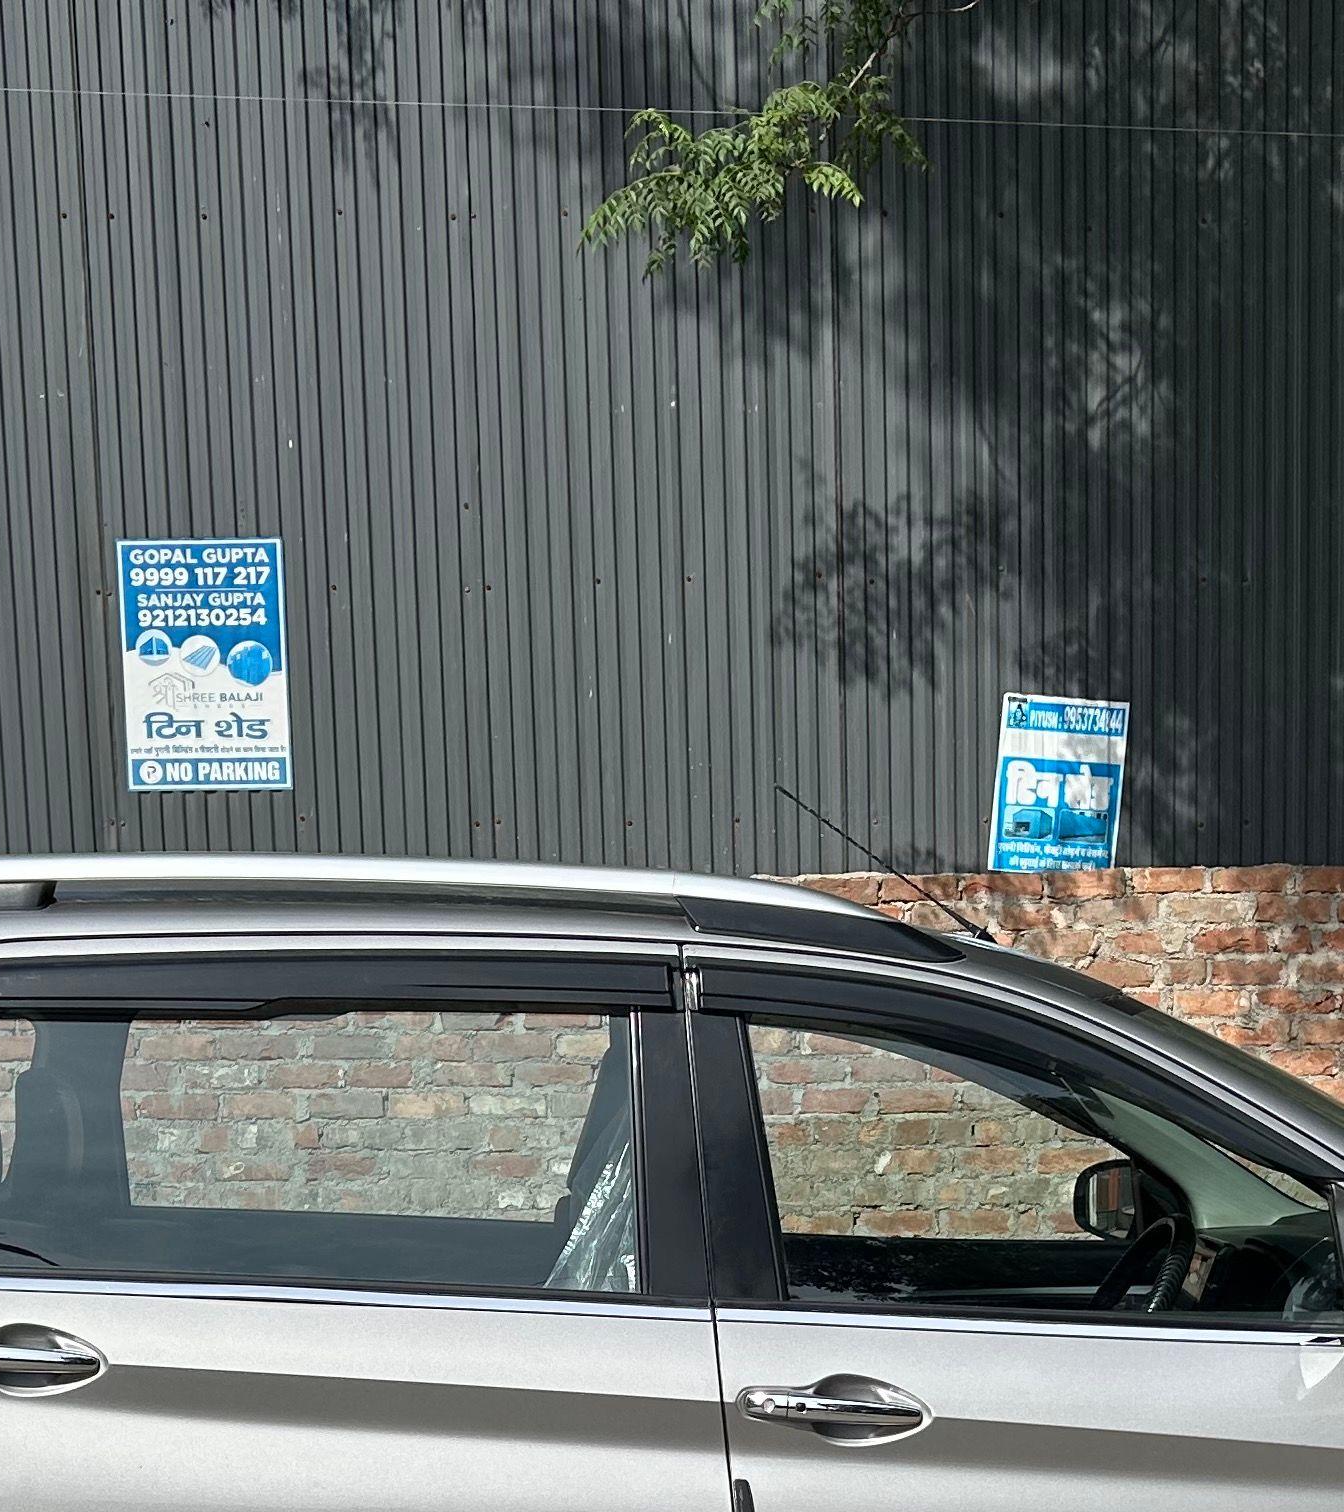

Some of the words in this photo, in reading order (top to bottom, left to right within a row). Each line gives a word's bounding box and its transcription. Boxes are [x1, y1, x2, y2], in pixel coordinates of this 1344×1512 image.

[129, 549, 198, 564] GOPAL
[202, 548, 269, 563] GUPTA
[129, 567, 189, 587] 9999
[195, 567, 228, 586] 117
[233, 566, 270, 585] 217
[137, 593, 205, 607] SANJAY
[208, 592, 266, 606] GUPTA
[138, 608, 267, 627] 9212130254
[176, 692, 216, 703] SHREE
[219, 692, 263, 702] BALAJI
[143, 712, 205, 740] टिन
[214, 712, 271, 740] शेड
[166, 762, 193, 782] NO
[198, 761, 281, 782] PARKING
